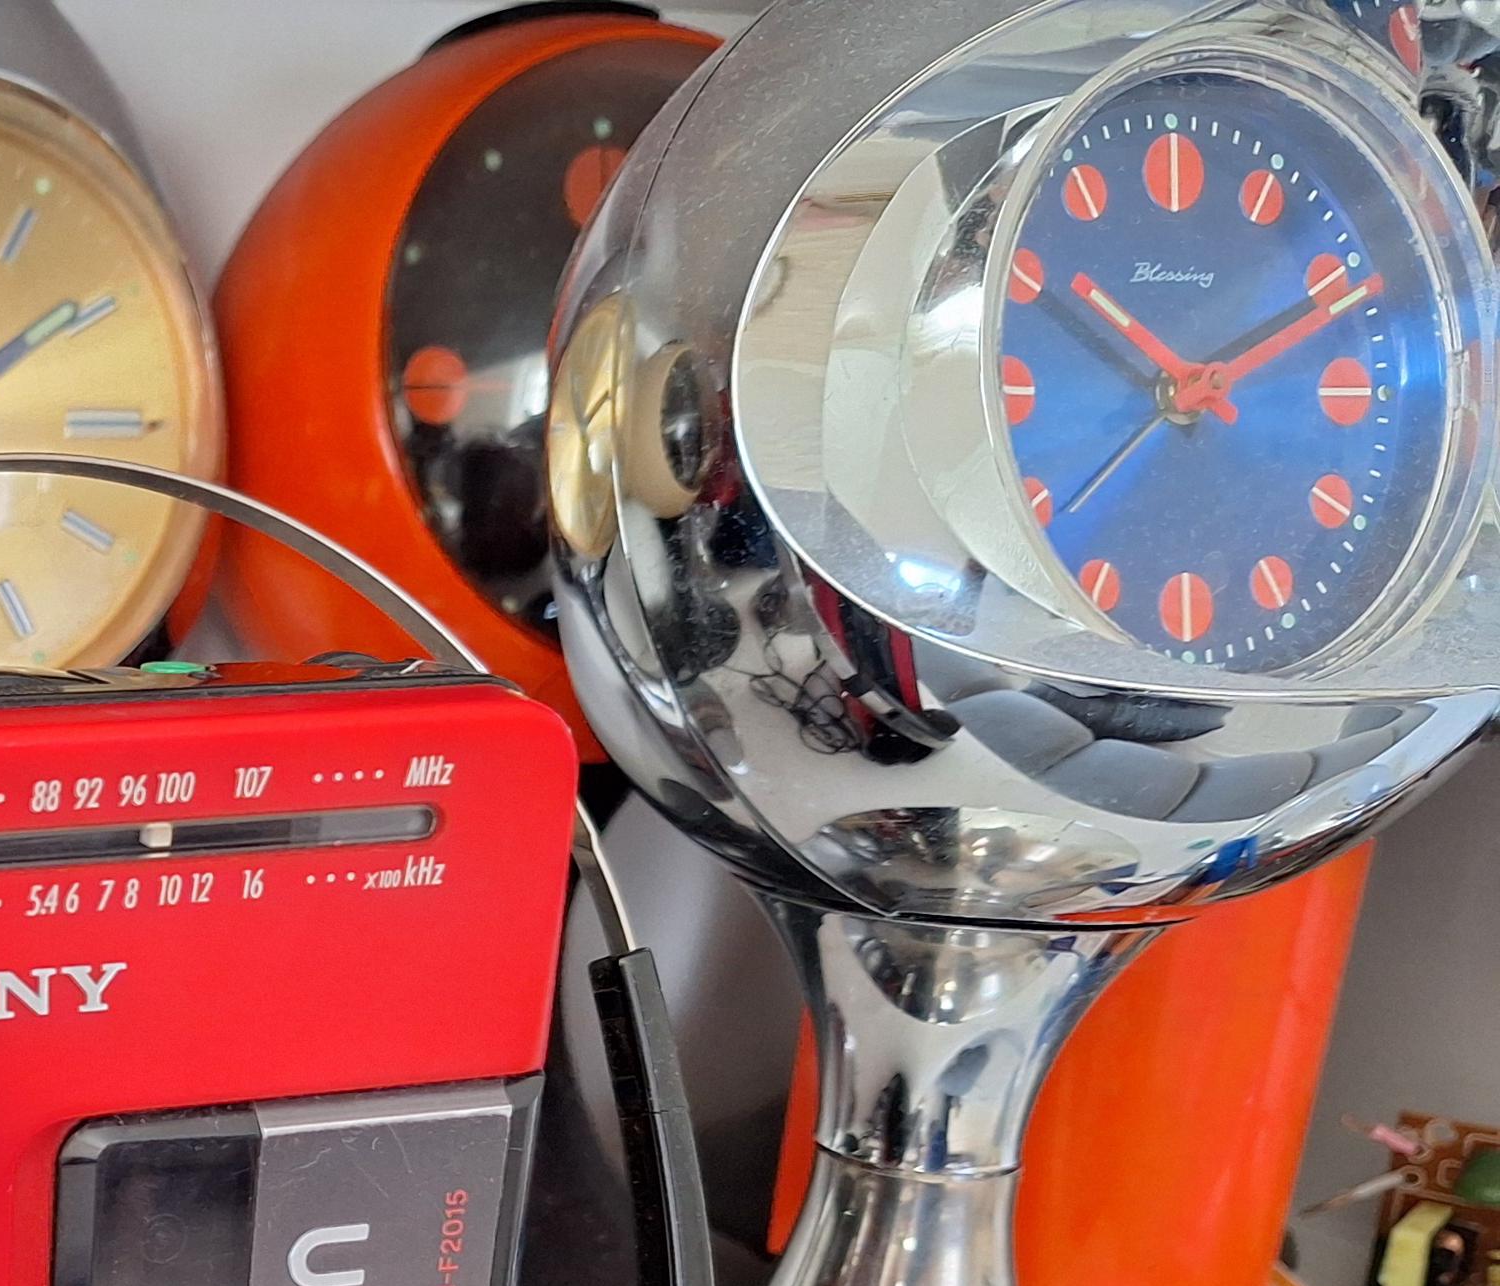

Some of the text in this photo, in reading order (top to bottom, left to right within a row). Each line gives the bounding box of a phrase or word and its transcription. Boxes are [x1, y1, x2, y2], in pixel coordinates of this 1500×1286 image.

[1129, 262, 1214, 288] Blessing
[31, 779, 62, 813] 88
[74, 777, 104, 810] 92
[119, 774, 148, 807] 96
[157, 771, 197, 804] 100
[235, 766, 274, 798] 107
[404, 755, 456, 787] MHz
[65, 882, 80, 914] 6
[97, 879, 115, 911] 7
[124, 878, 140, 909] 8
[159, 874, 183, 906] 10
[191, 872, 214, 903] 12
[242, 868, 265, 899] 16
